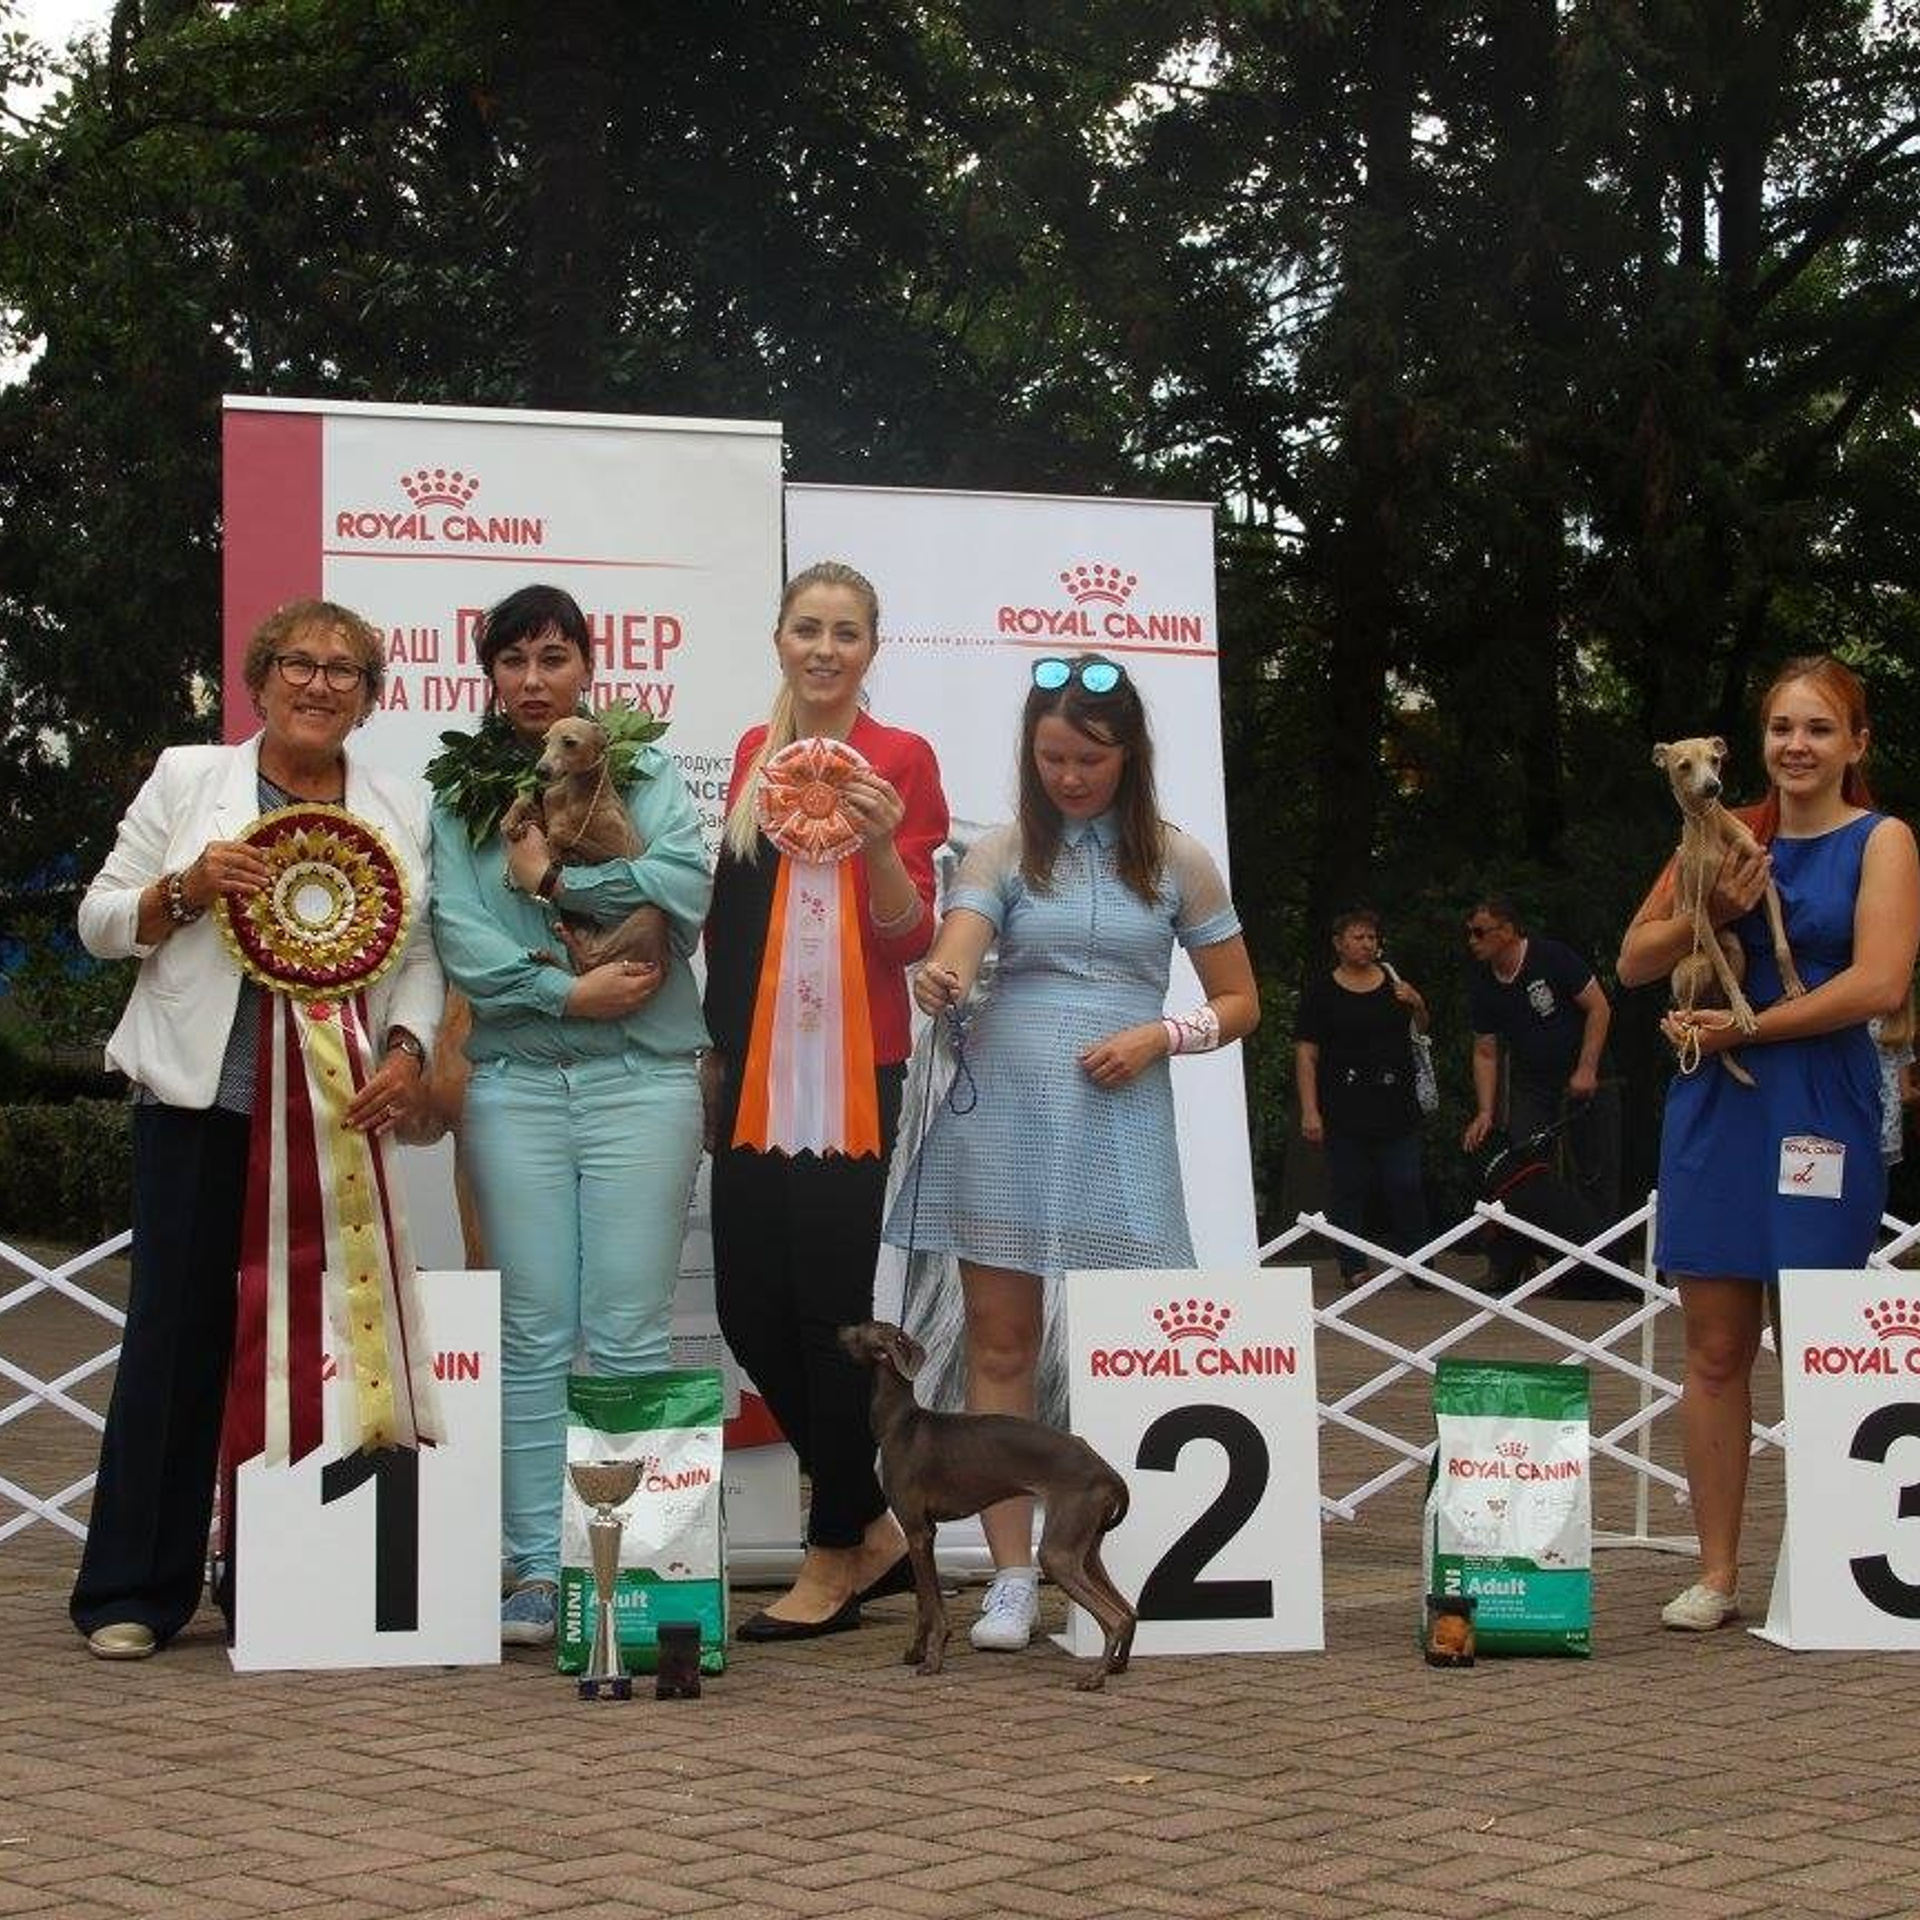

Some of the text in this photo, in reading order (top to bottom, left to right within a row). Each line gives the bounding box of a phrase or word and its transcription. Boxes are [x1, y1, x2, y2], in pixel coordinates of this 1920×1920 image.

[336, 511, 543, 545] ROYAL CANIN
[387, 608, 682, 671] АШ ПНЕР
[998, 606, 1202, 643] ROYAL CANIN
[594, 682, 675, 718] ПЕХУ
[1091, 1347, 1296, 1377] ROYAL CANIN
[1804, 1347, 1899, 1374] ROYAL
[646, 1468, 712, 1493] CANIN
[1448, 1457, 1582, 1481] ROYAL CANIN
[1136, 1404, 1274, 1621] 2
[321, 1445, 419, 1632] 1
[1467, 1577, 1527, 1596] Adult
[566, 1582, 583, 1644] MINI
